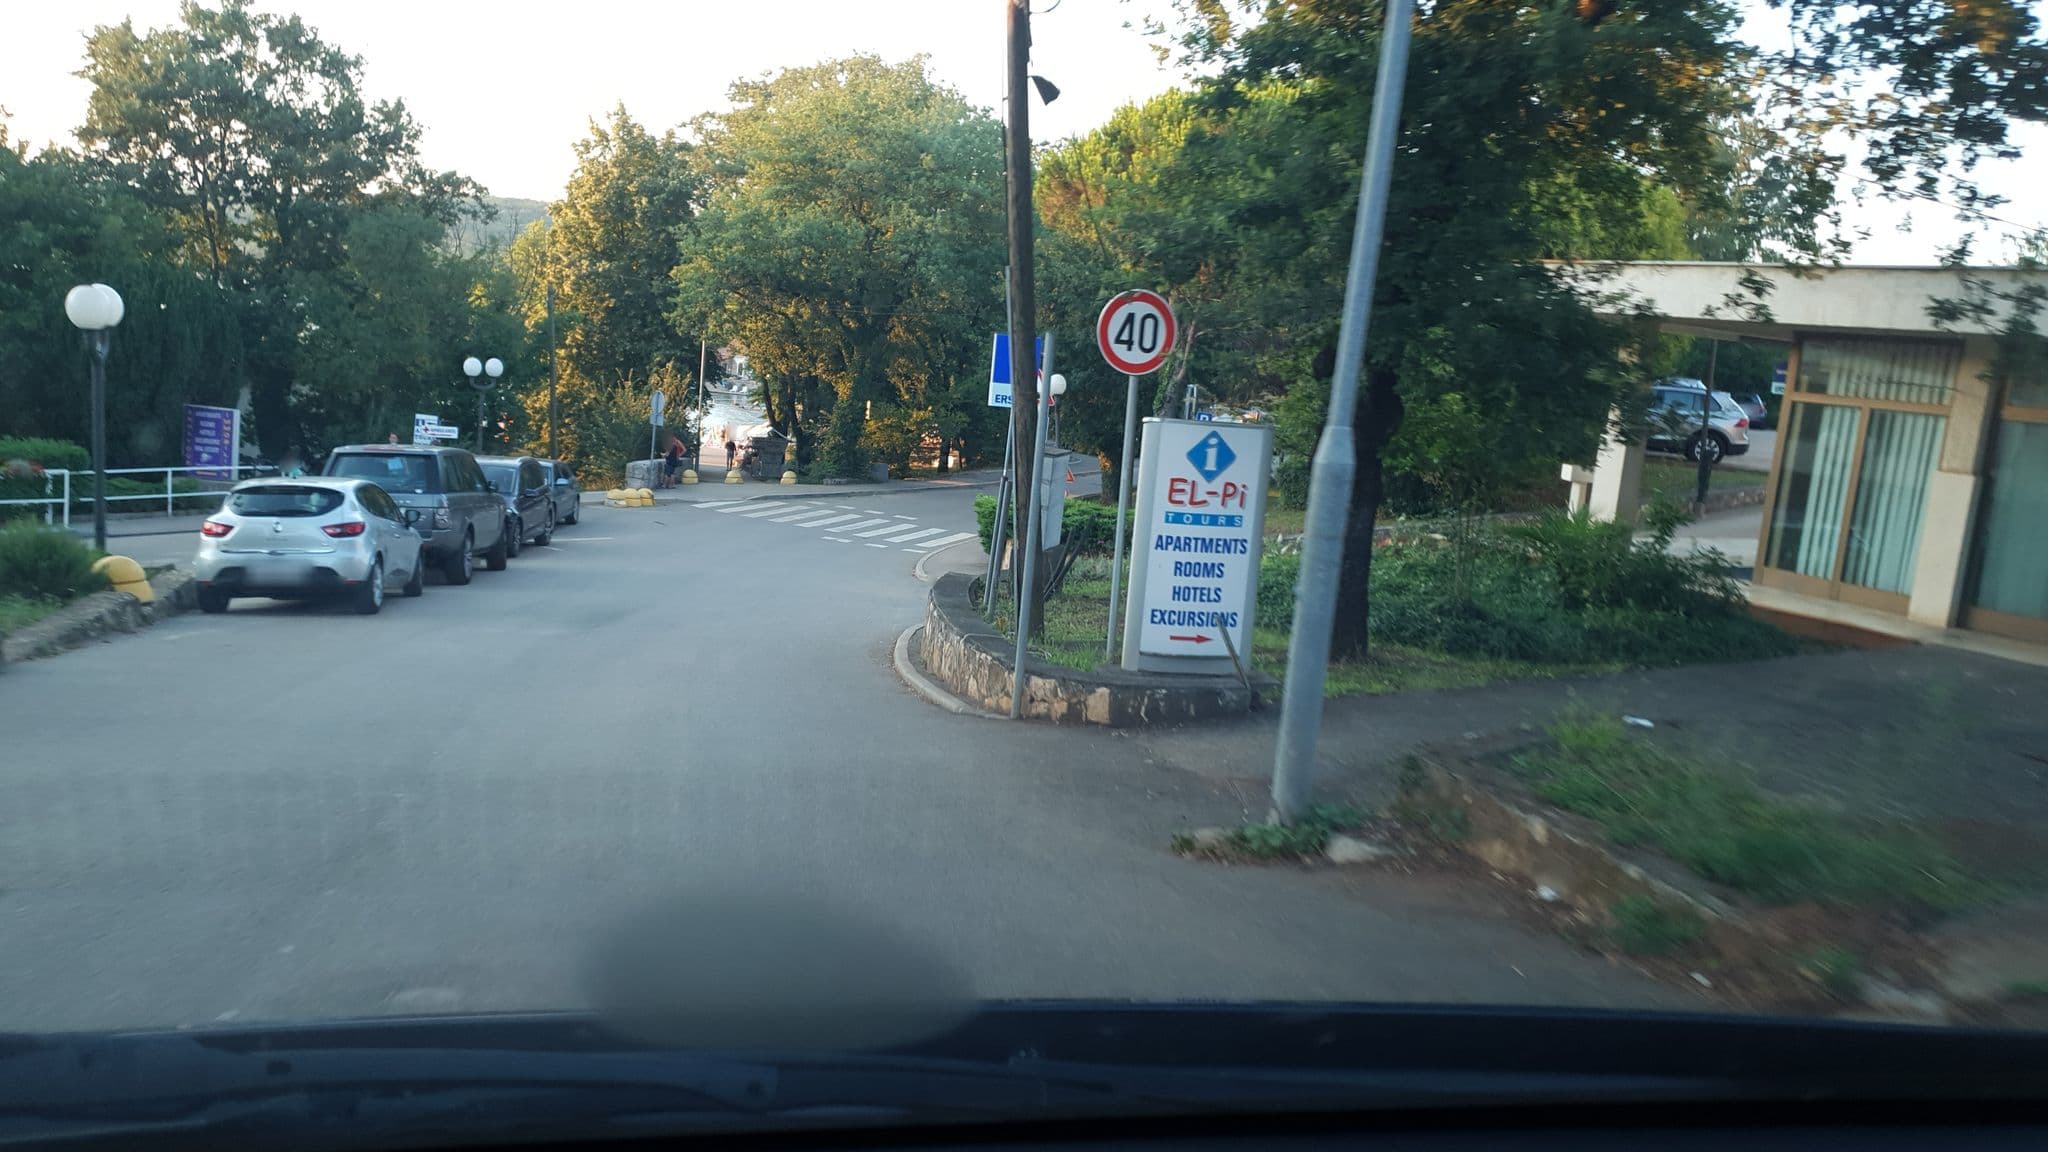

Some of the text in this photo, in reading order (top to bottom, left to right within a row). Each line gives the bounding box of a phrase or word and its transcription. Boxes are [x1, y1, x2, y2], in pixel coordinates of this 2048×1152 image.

[1114, 312, 1158, 354] 40
[1167, 513, 1242, 527] TOURS
[1155, 534, 1248, 554] APARTMENTS
[1174, 561, 1225, 578] ROOMS
[1172, 585, 1222, 603] HOTELS
[1150, 609, 1238, 628] EXCURSIONS
